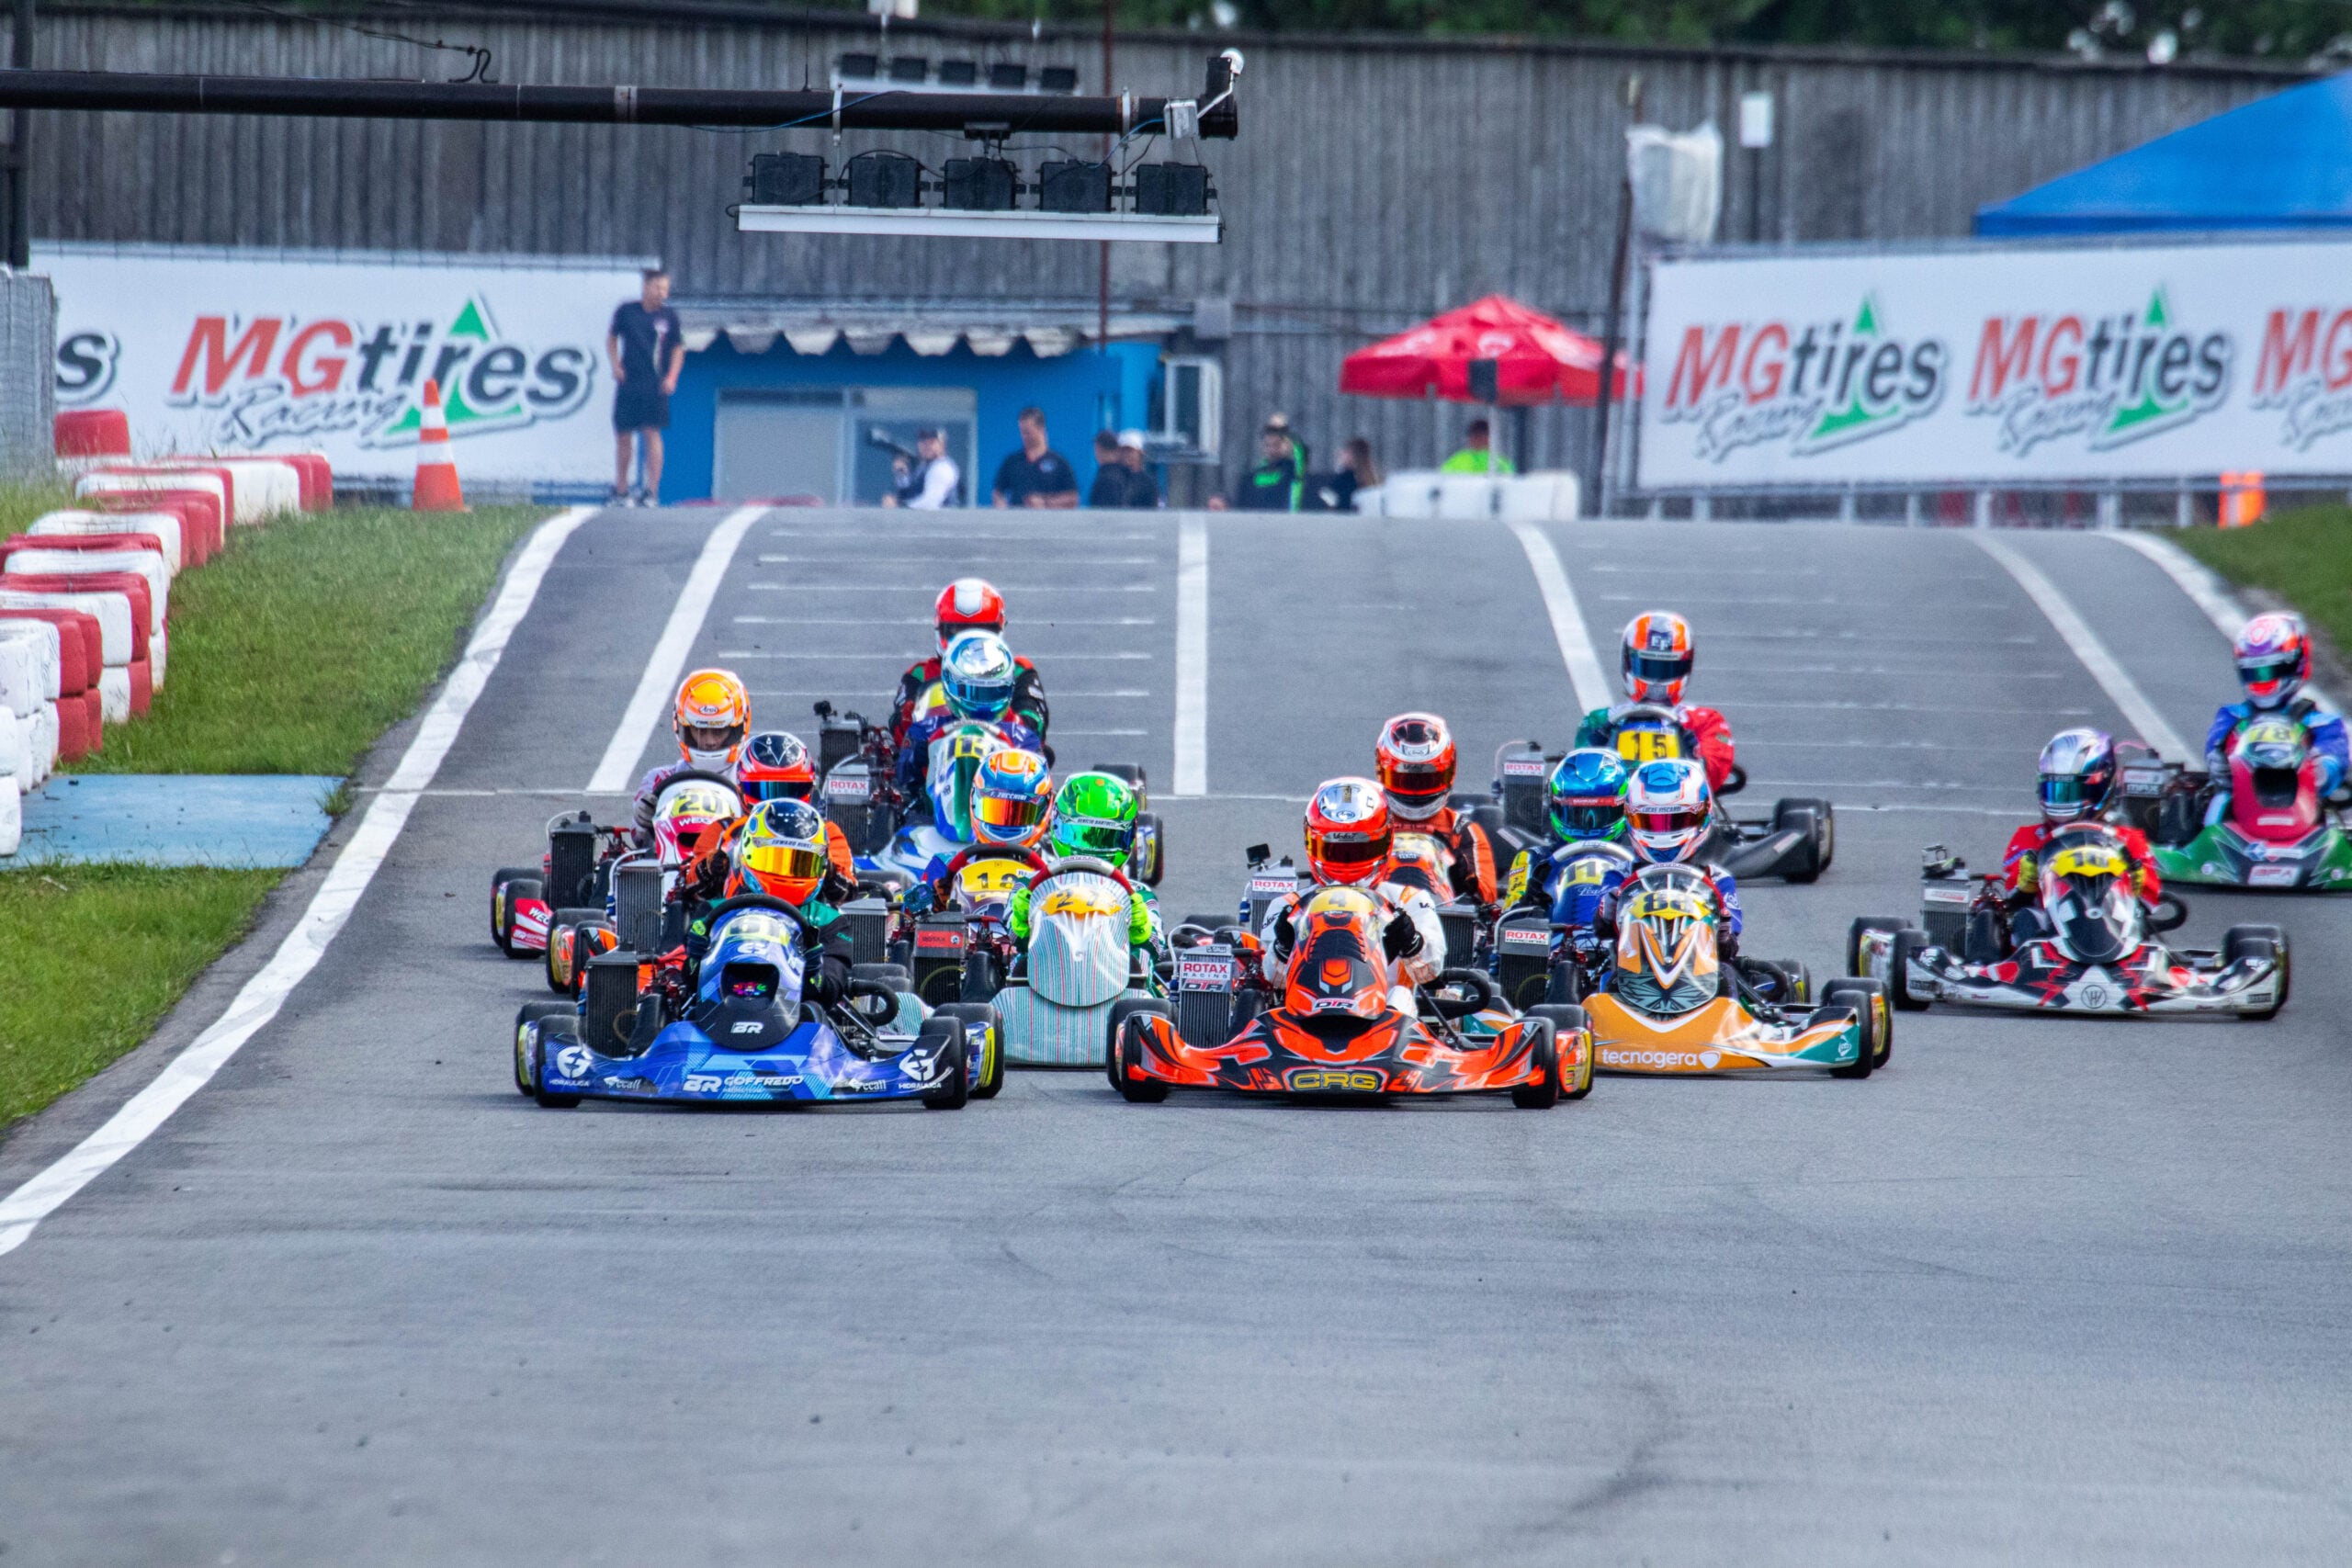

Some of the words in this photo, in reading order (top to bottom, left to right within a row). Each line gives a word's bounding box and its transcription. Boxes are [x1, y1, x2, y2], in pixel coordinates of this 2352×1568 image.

[1631, 733, 1667, 759] 15
[831, 781, 866, 789] ROTAX
[1254, 880, 1294, 888] ROTAX
[1056, 889, 1099, 908] 27
[1329, 890, 1347, 908] 4
[1506, 931, 1546, 940] ROTAX
[1183, 963, 1227, 974] ROTAX
[1602, 1049, 1698, 1068] tecnogera
[724, 1075, 803, 1087] GOFFREDO
[1294, 1072, 1377, 1090] CRG
